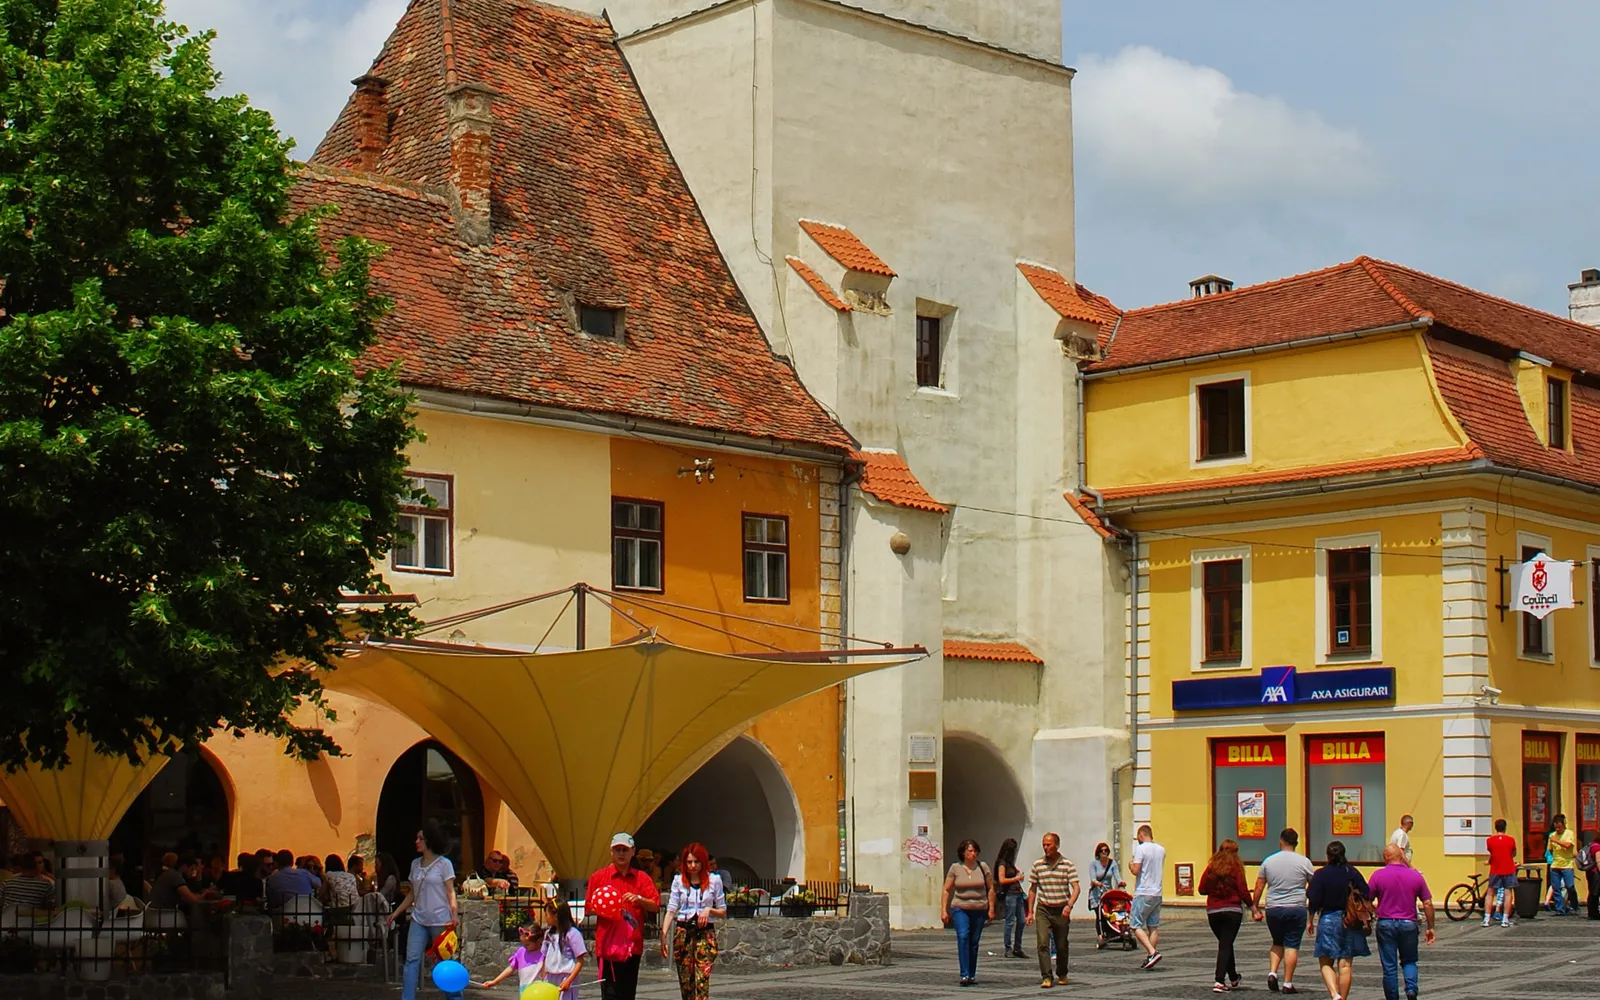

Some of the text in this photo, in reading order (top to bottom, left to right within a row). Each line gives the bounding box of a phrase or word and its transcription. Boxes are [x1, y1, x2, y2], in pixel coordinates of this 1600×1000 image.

[1522, 594, 1558, 605] Council
[1261, 686, 1287, 702] AXA
[1311, 686, 1388, 699] AXA ASIGURARI
[1228, 745, 1273, 763] BILLA
[1322, 741, 1370, 760] BILLA
[1524, 741, 1550, 759] BILLA
